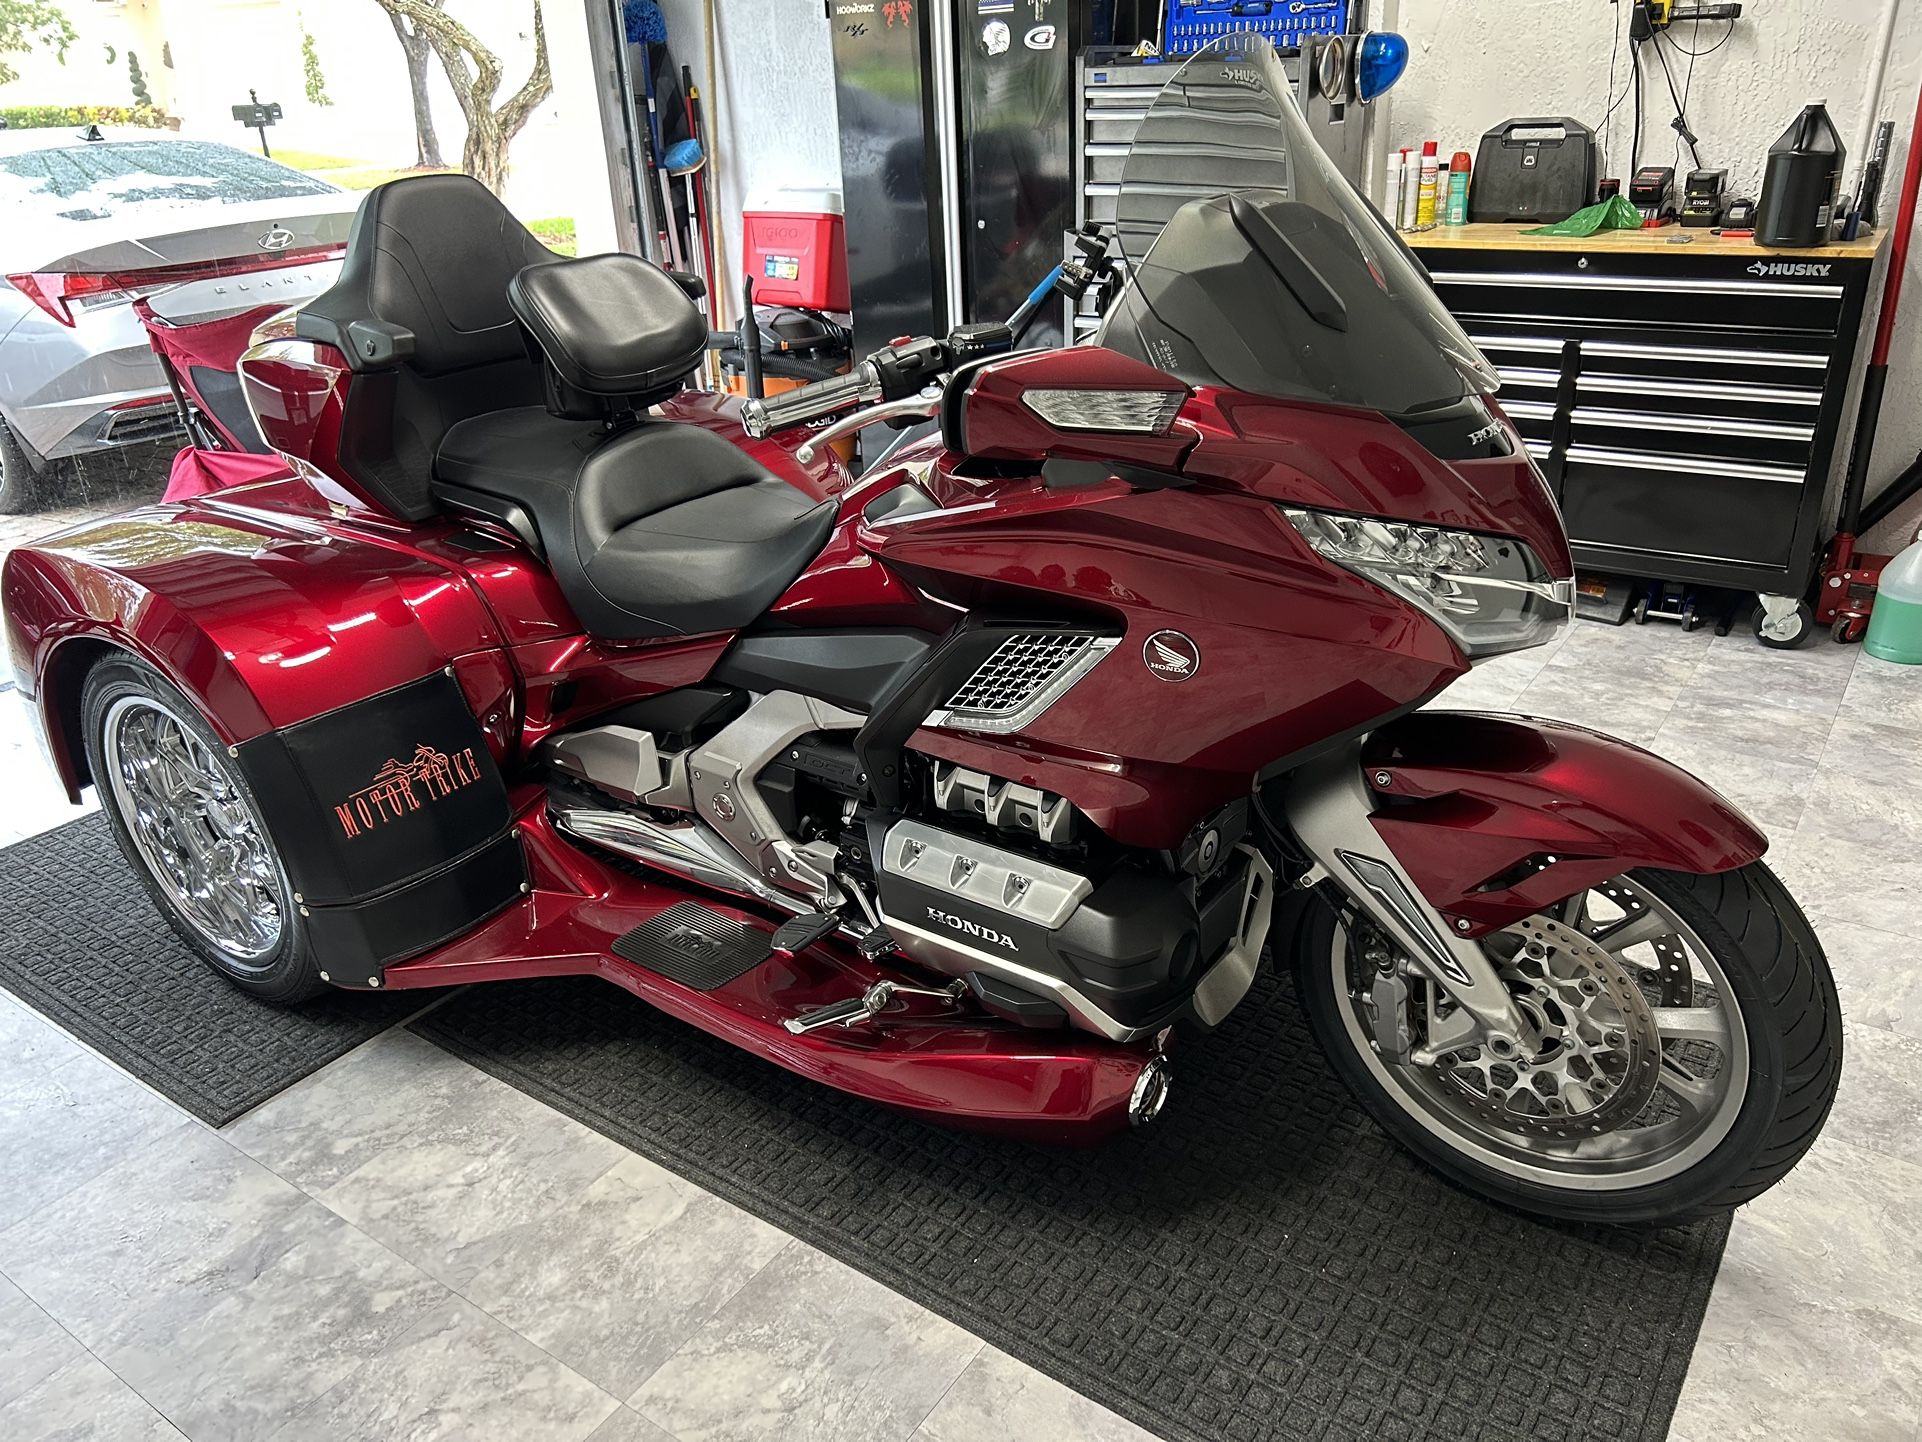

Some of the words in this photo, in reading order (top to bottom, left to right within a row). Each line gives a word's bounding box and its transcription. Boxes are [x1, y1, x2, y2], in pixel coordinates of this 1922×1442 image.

[1768, 263, 1831, 276] HUSKY
[1150, 662, 1190, 674] HONDA
[334, 778, 420, 839] MOTOR
[419, 748, 481, 800] TRIKE
[927, 906, 1019, 952] HONDA
